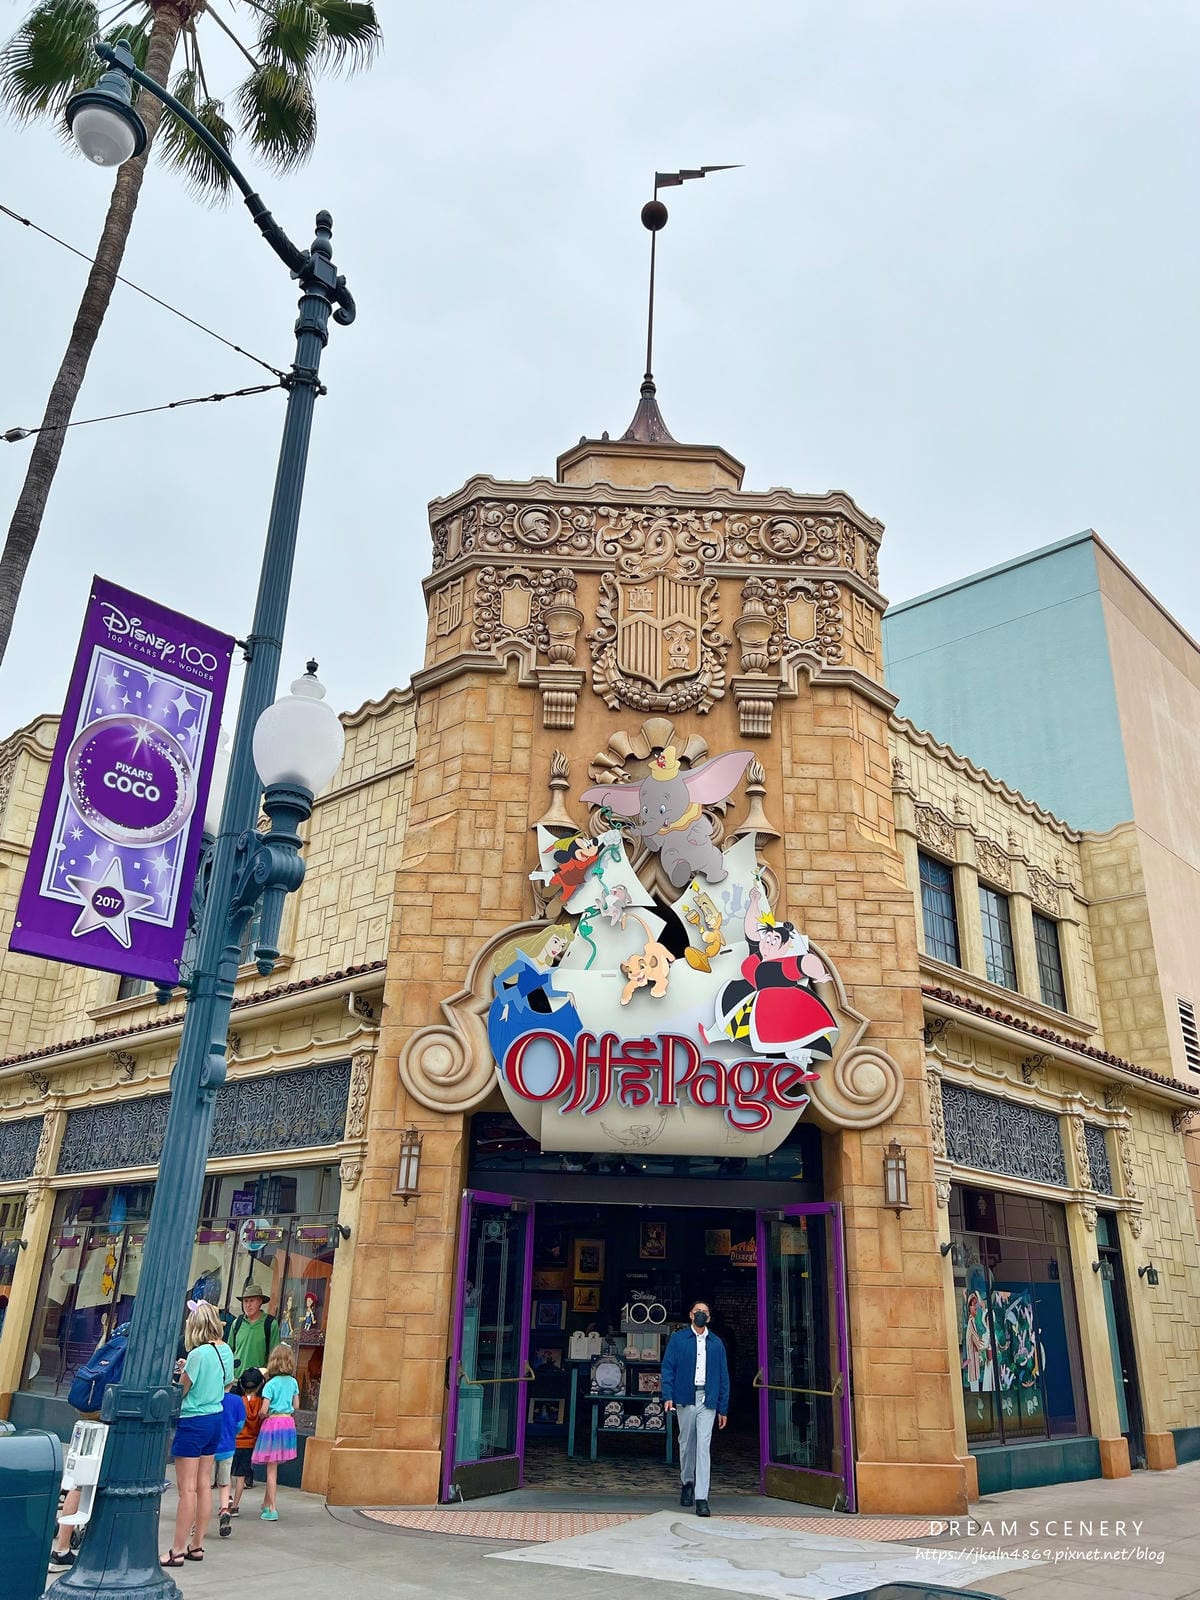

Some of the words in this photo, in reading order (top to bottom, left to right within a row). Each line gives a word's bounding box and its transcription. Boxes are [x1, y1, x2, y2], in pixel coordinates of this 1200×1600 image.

[107, 632, 123, 643] 100
[127, 641, 157, 658] YEARS
[178, 661, 214, 682] WONDER
[178, 643, 217, 671] 100
[115, 762, 153, 782] PIXAR'S
[103, 771, 161, 802] COCO
[95, 894, 122, 910] 2017
[504, 1030, 620, 1114] Off
[657, 1034, 808, 1132] Page
[620, 1302, 667, 1325] 100
